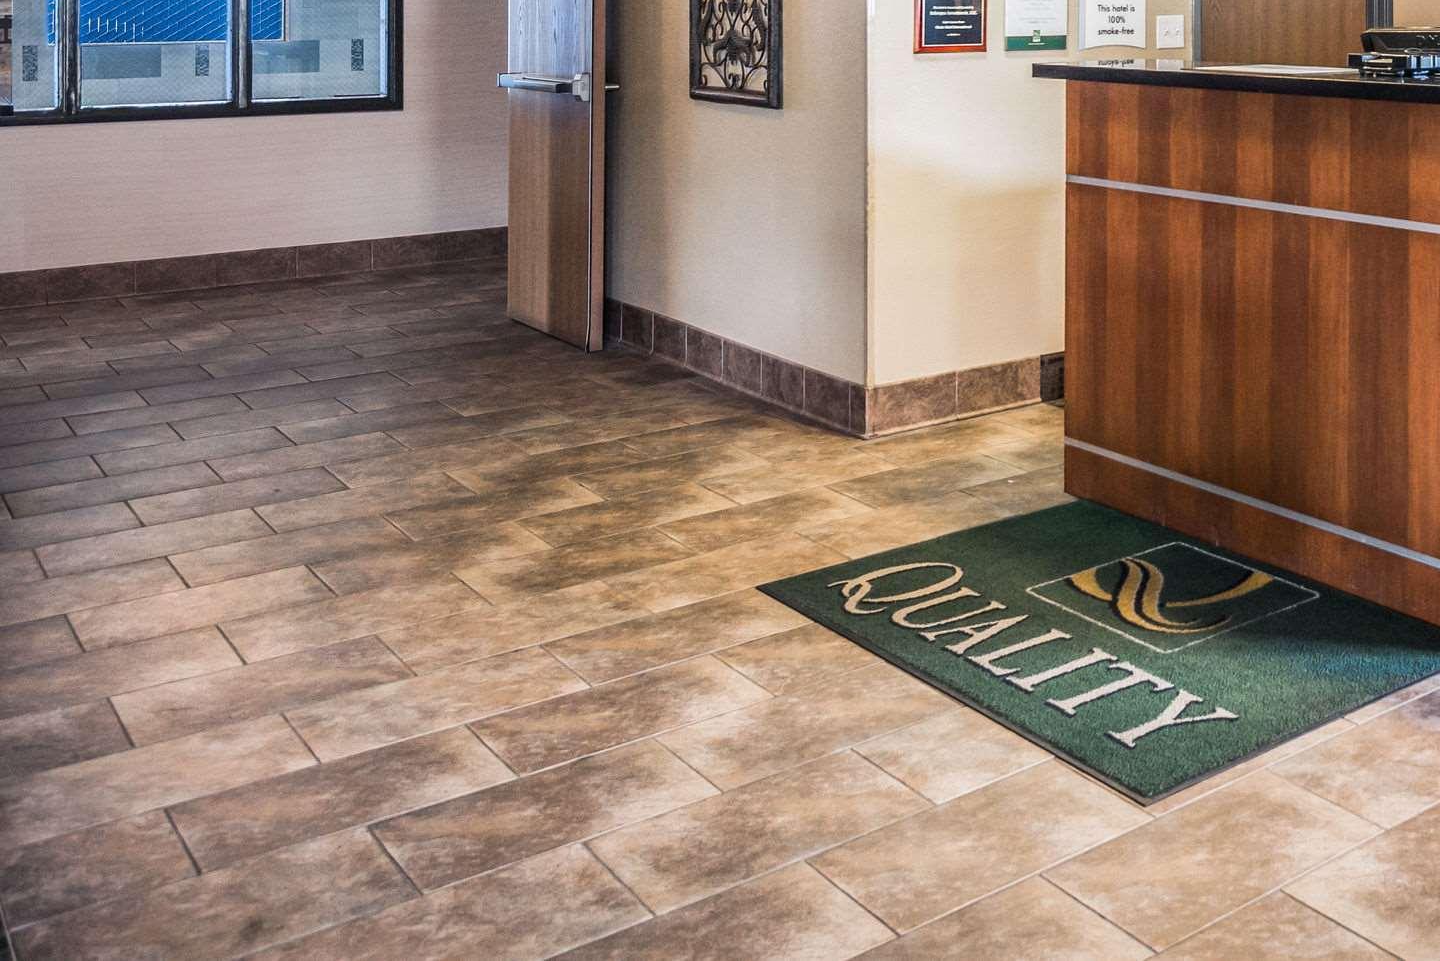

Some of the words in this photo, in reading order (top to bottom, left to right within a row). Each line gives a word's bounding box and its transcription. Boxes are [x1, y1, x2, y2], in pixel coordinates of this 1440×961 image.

[1097, 4, 1110, 12] This
[1112, 4, 1129, 12] hotel
[1108, 15, 1126, 23] 100%
[1097, 27, 1135, 35] smoke-free
[827, 561, 1240, 749] QUALITY
